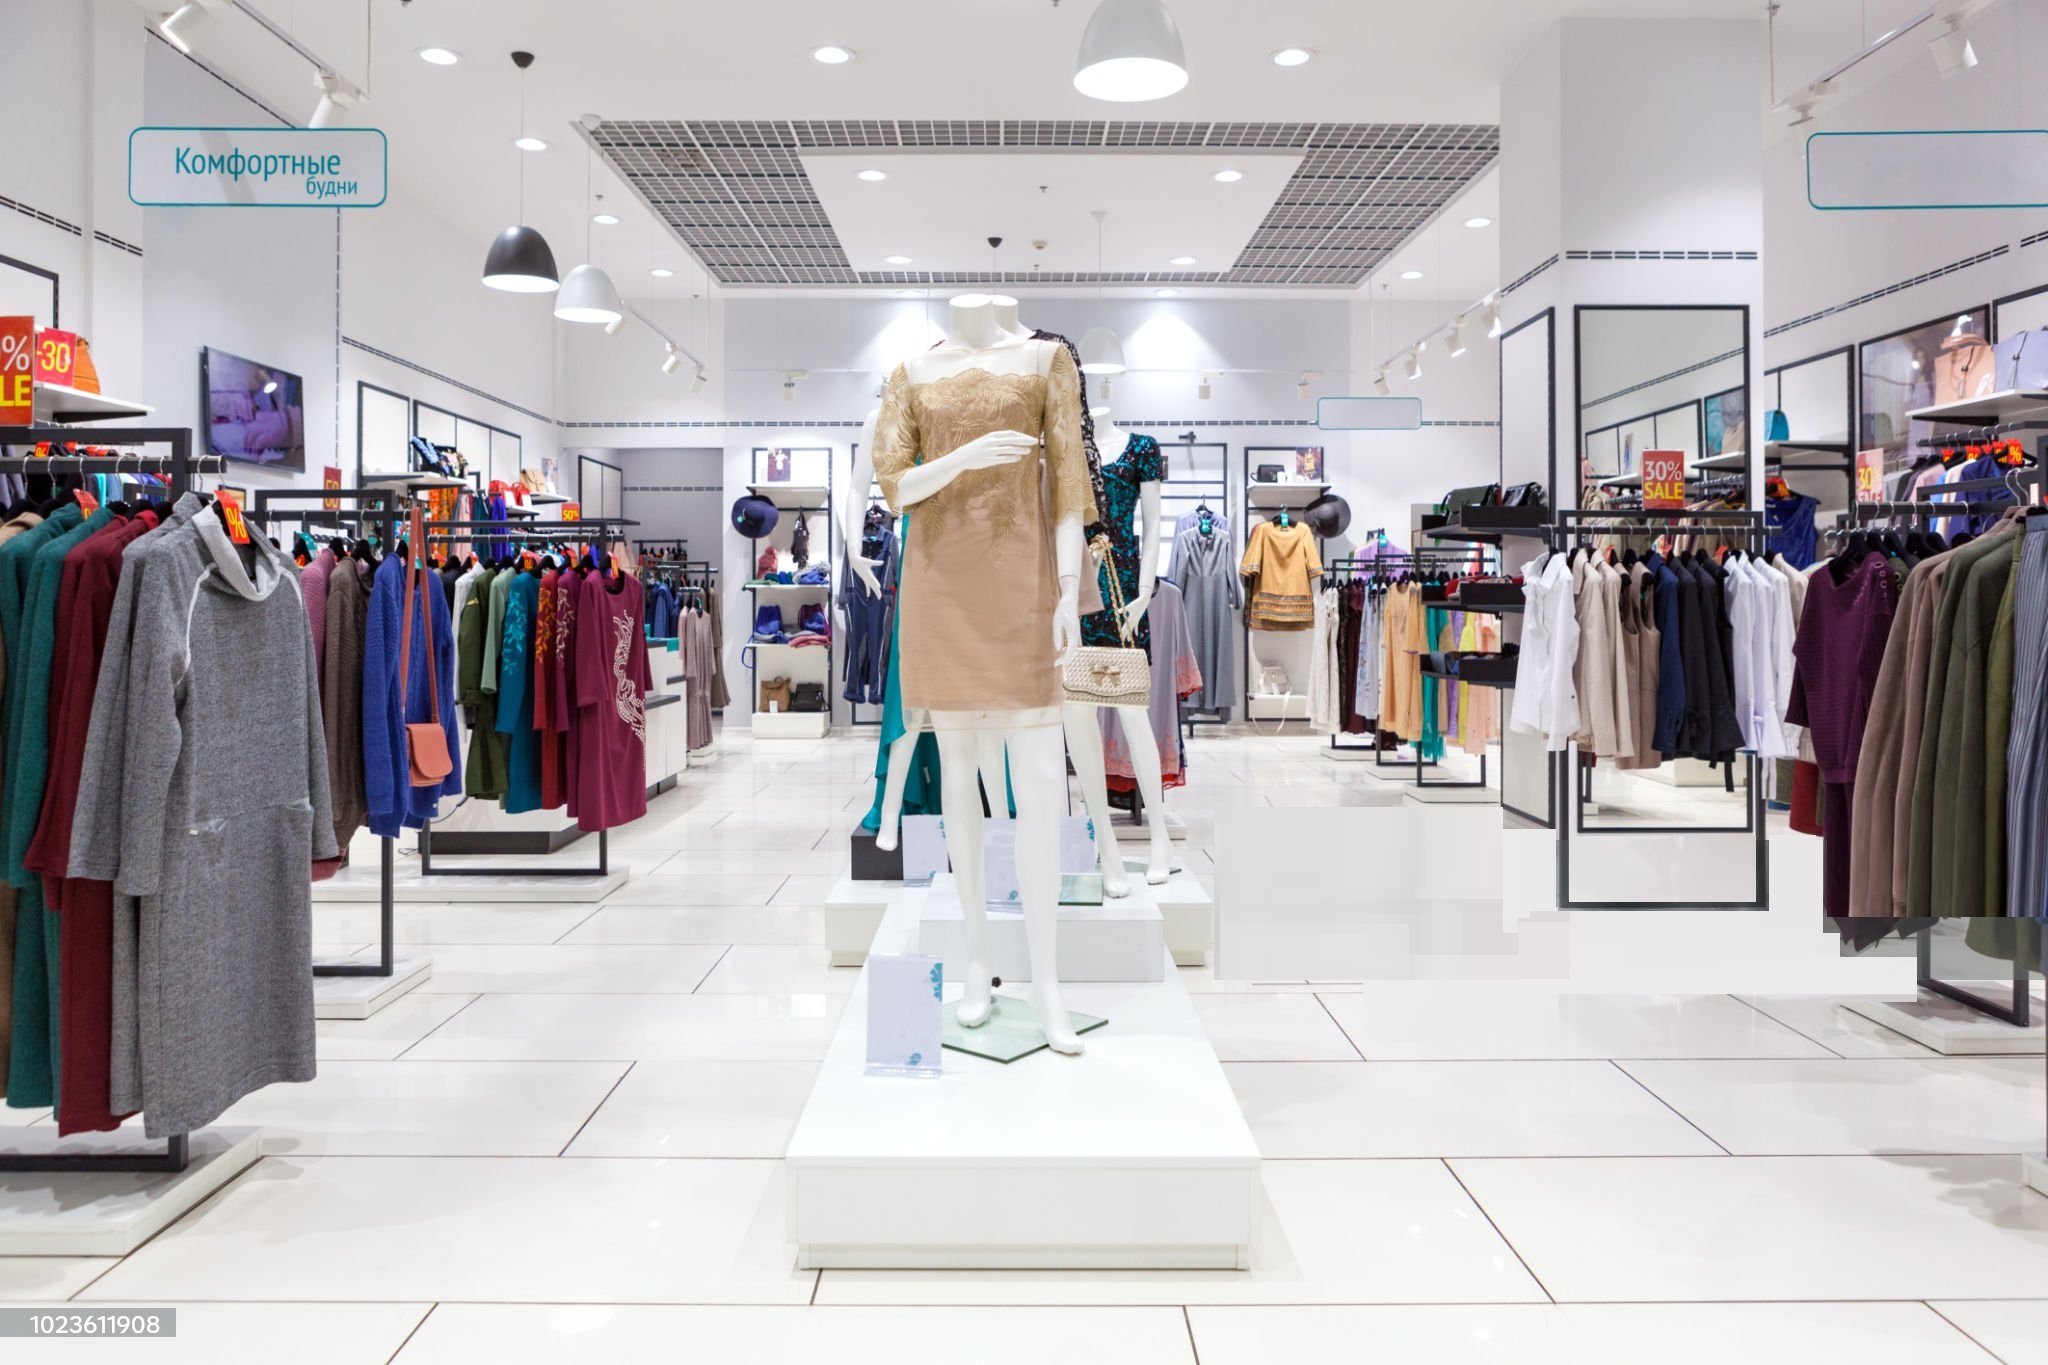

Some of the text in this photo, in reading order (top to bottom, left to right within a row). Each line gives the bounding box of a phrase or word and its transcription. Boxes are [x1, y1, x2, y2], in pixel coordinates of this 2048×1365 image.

[175, 147, 341, 182] Комфортные
[305, 176, 358, 199] будни
[0, 374, 32, 407] LE
[1644, 460, 1683, 481] 30%
[1643, 481, 1684, 500] SALE
